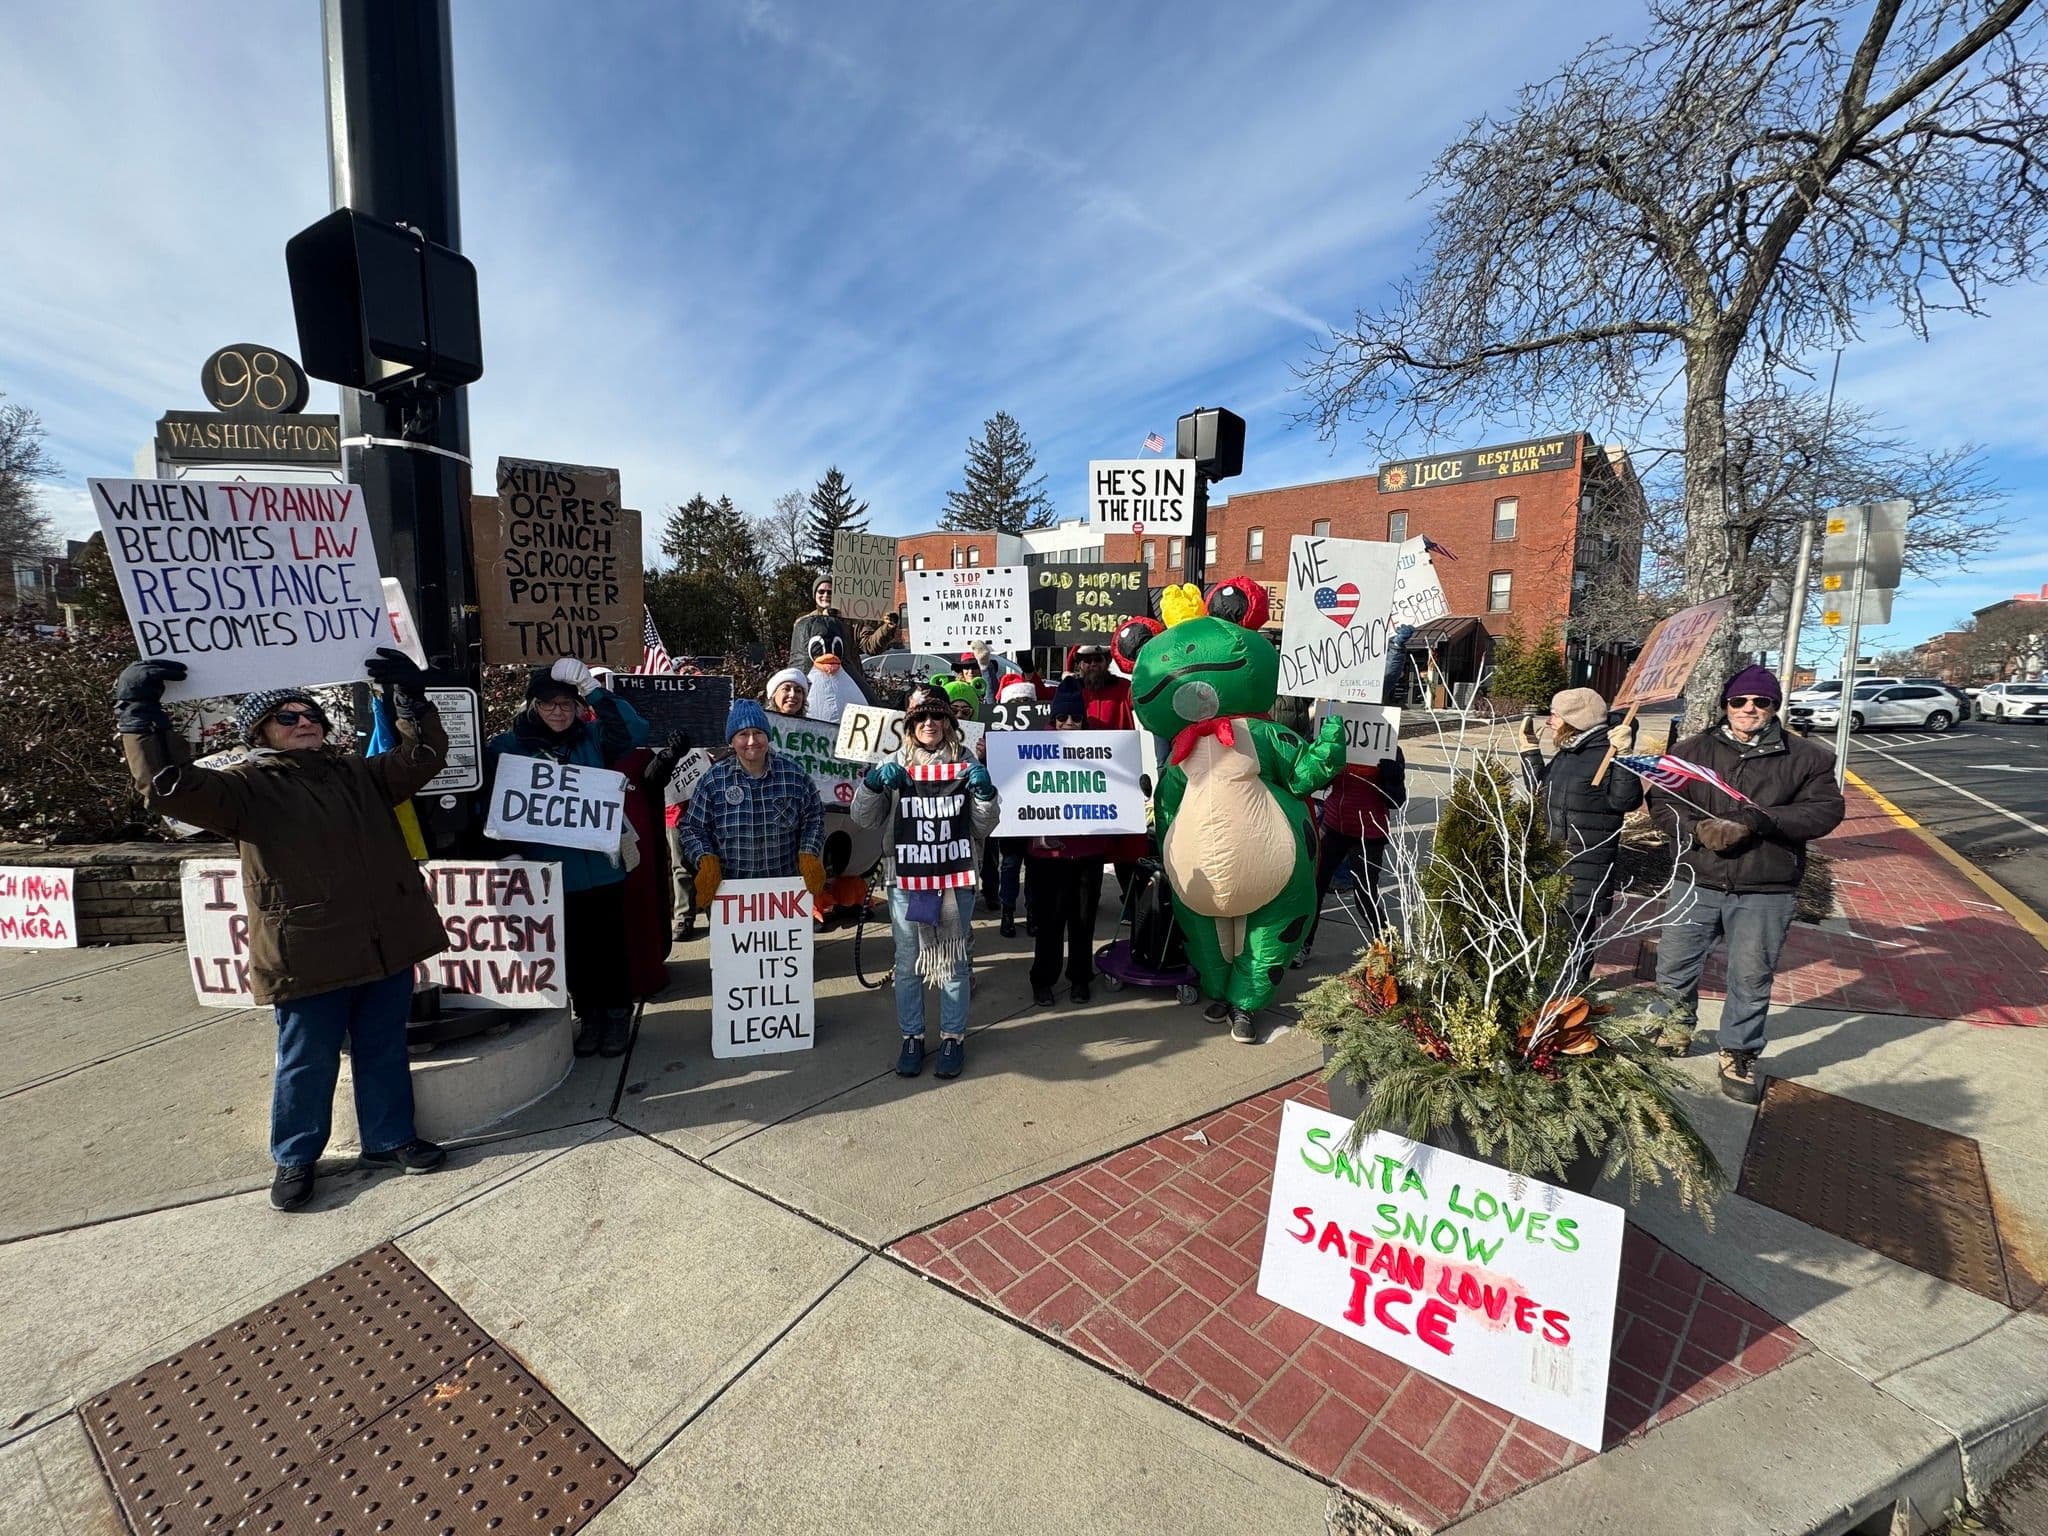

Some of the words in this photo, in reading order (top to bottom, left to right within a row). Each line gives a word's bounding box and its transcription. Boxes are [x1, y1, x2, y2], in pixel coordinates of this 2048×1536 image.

[213, 351, 287, 410] 98
[165, 422, 339, 451] WASHINGTON
[1478, 441, 1564, 466] RESTAURANT
[1498, 463, 1509, 475] &
[1512, 458, 1540, 474] BAR
[1097, 469, 1147, 496] HE'S
[1155, 468, 1185, 496] IN
[97, 483, 209, 521] WHEN
[219, 486, 353, 522] TYRANNY
[1098, 499, 1129, 521] THE
[1133, 498, 1183, 522] FILES
[116, 526, 275, 563] BECOMES
[289, 527, 358, 560] LAW
[510, 520, 611, 553] GRINCH
[836, 532, 896, 556] IMPEACH
[504, 548, 617, 581] SCROOGE
[835, 554, 894, 576] CONVICT
[953, 572, 981, 582] STOP
[1292, 539, 1338, 592] WE
[131, 563, 362, 615] RESISTANCE
[509, 578, 619, 605] POTTER
[833, 576, 892, 599] REMOVE
[1039, 571, 1073, 589] OLD
[1078, 571, 1142, 591] HIPPIE
[936, 588, 1014, 600] TERRORIZING
[940, 599, 1010, 611] IMMIGRANTS
[1076, 590, 1114, 607] FOR
[552, 606, 600, 622] AND
[840, 597, 889, 619] NOW
[963, 613, 985, 622] AND
[137, 612, 297, 656] BECOMES
[304, 607, 381, 643] DUTY
[947, 625, 1003, 636] CITIZENS
[1033, 609, 1072, 632] FREE
[1078, 611, 1129, 633] SPEEC
[508, 621, 618, 662] TRUMP
[1281, 613, 1392, 691] DEMOCRACY
[620, 678, 646, 689] THE
[654, 678, 697, 691] FILES
[1340, 679, 1380, 687] ESTABLISHED
[1347, 688, 1367, 698] 1776
[847, 713, 903, 754] RIS
[1017, 744, 1060, 760] WOKE
[1062, 746, 1112, 760] means
[530, 762, 581, 793] BE
[671, 752, 702, 780] EPSTEIN
[674, 768, 701, 793] FILES
[1027, 770, 1107, 793] CARING
[502, 789, 621, 831] DECENT
[900, 794, 966, 819] TRUMP
[1018, 805, 1061, 820] about
[1063, 803, 1118, 820] OTHERS
[916, 820, 935, 843] IS
[940, 820, 952, 842] A
[895, 838, 971, 864] TRAITOR
[199, 869, 238, 911] I
[26, 903, 49, 916] LA
[714, 889, 809, 925] THINK
[0, 916, 68, 940] MIGRA
[731, 928, 802, 954] WHILE
[194, 957, 251, 994] LIK
[439, 959, 483, 994] IN
[487, 957, 558, 994] WW2
[759, 956, 799, 980] IT'S
[727, 984, 800, 1011] STILL
[730, 1013, 810, 1045] LEGAL
[1300, 1128, 1428, 1200] SANTA
[1448, 1183, 1580, 1253] LOVES
[1371, 1203, 1505, 1266] SNOW
[1286, 1206, 1426, 1291] SATAN
[1436, 1265, 1571, 1348] LOVES
[1343, 1268, 1457, 1356] ICE
